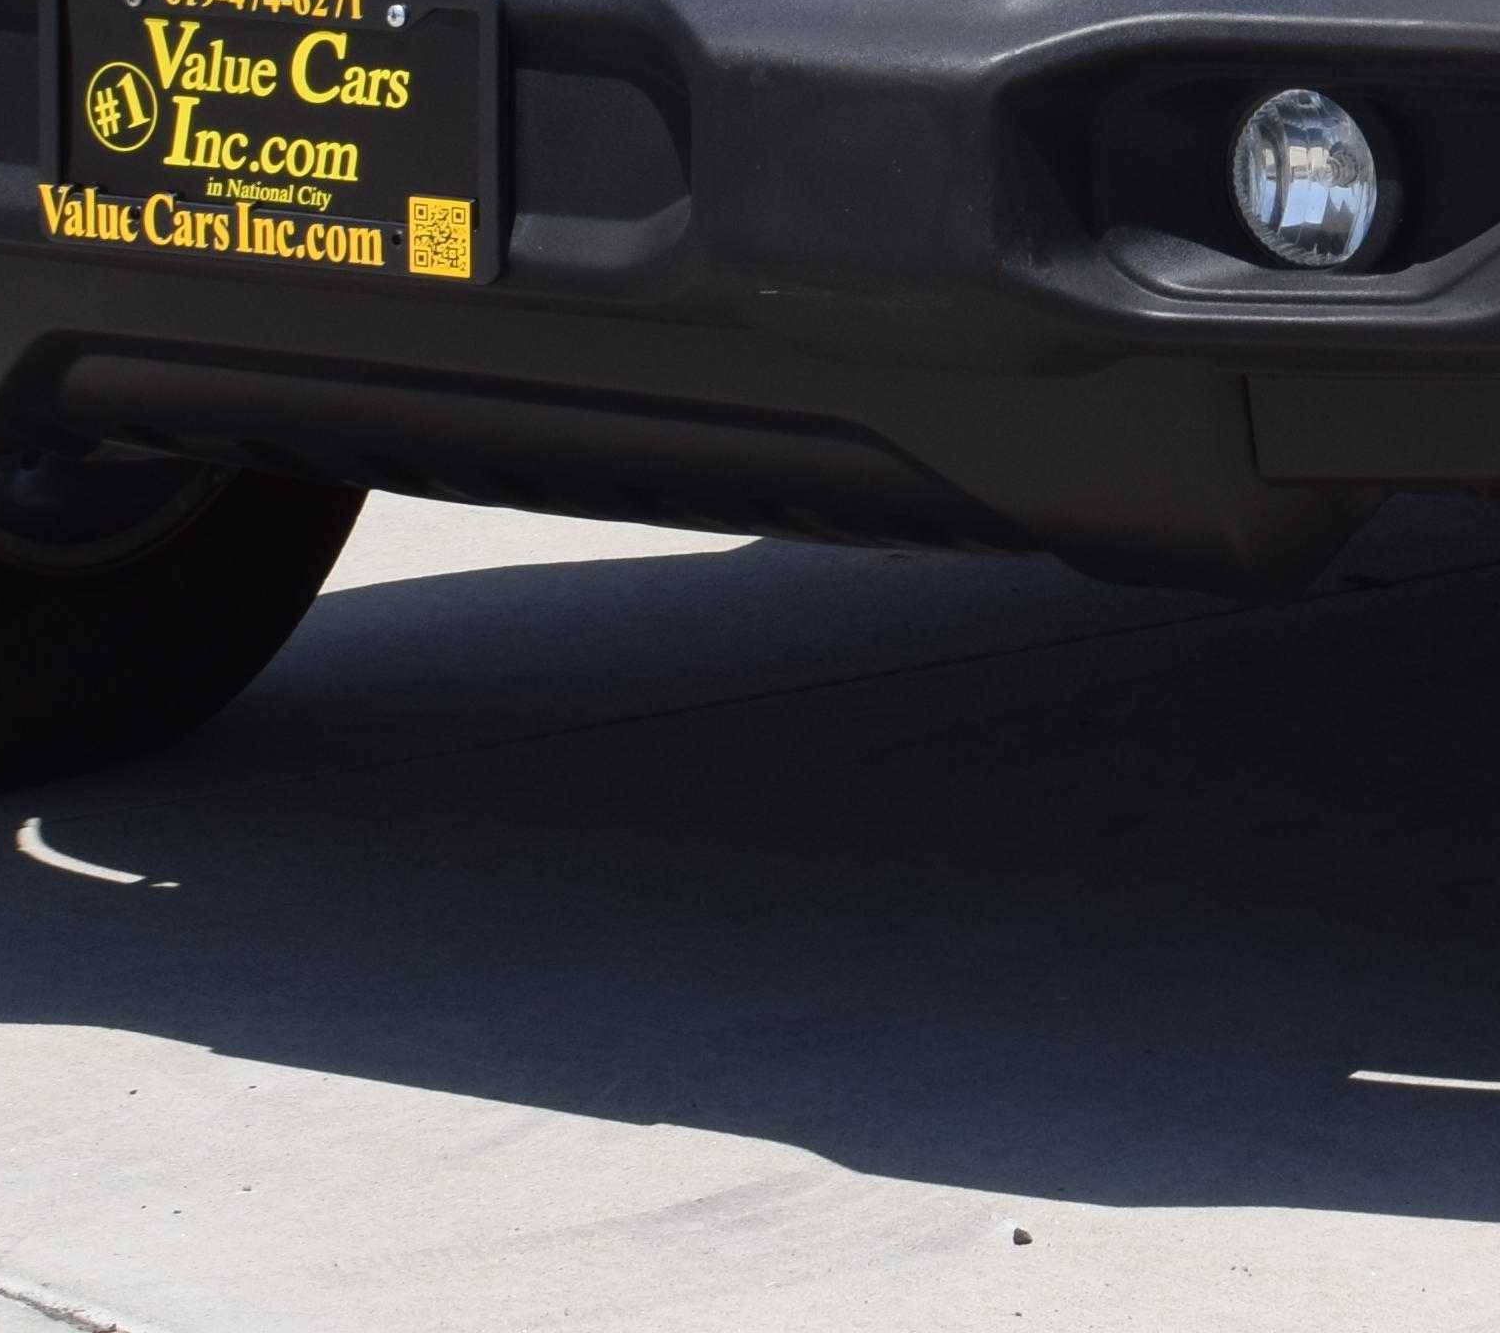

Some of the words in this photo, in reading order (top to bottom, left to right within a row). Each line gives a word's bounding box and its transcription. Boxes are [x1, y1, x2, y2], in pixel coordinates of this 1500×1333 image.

[143, 17, 278, 97] Value
[292, 30, 410, 109] Cars
[94, 72, 150, 137] #1
[163, 95, 359, 181] Inc.com
[38, 184, 140, 242] Value
[144, 192, 230, 251] Cars
[235, 200, 386, 266] Inc.com
[206, 176, 223, 197] in
[227, 178, 294, 204] National
[297, 186, 332, 211] City
